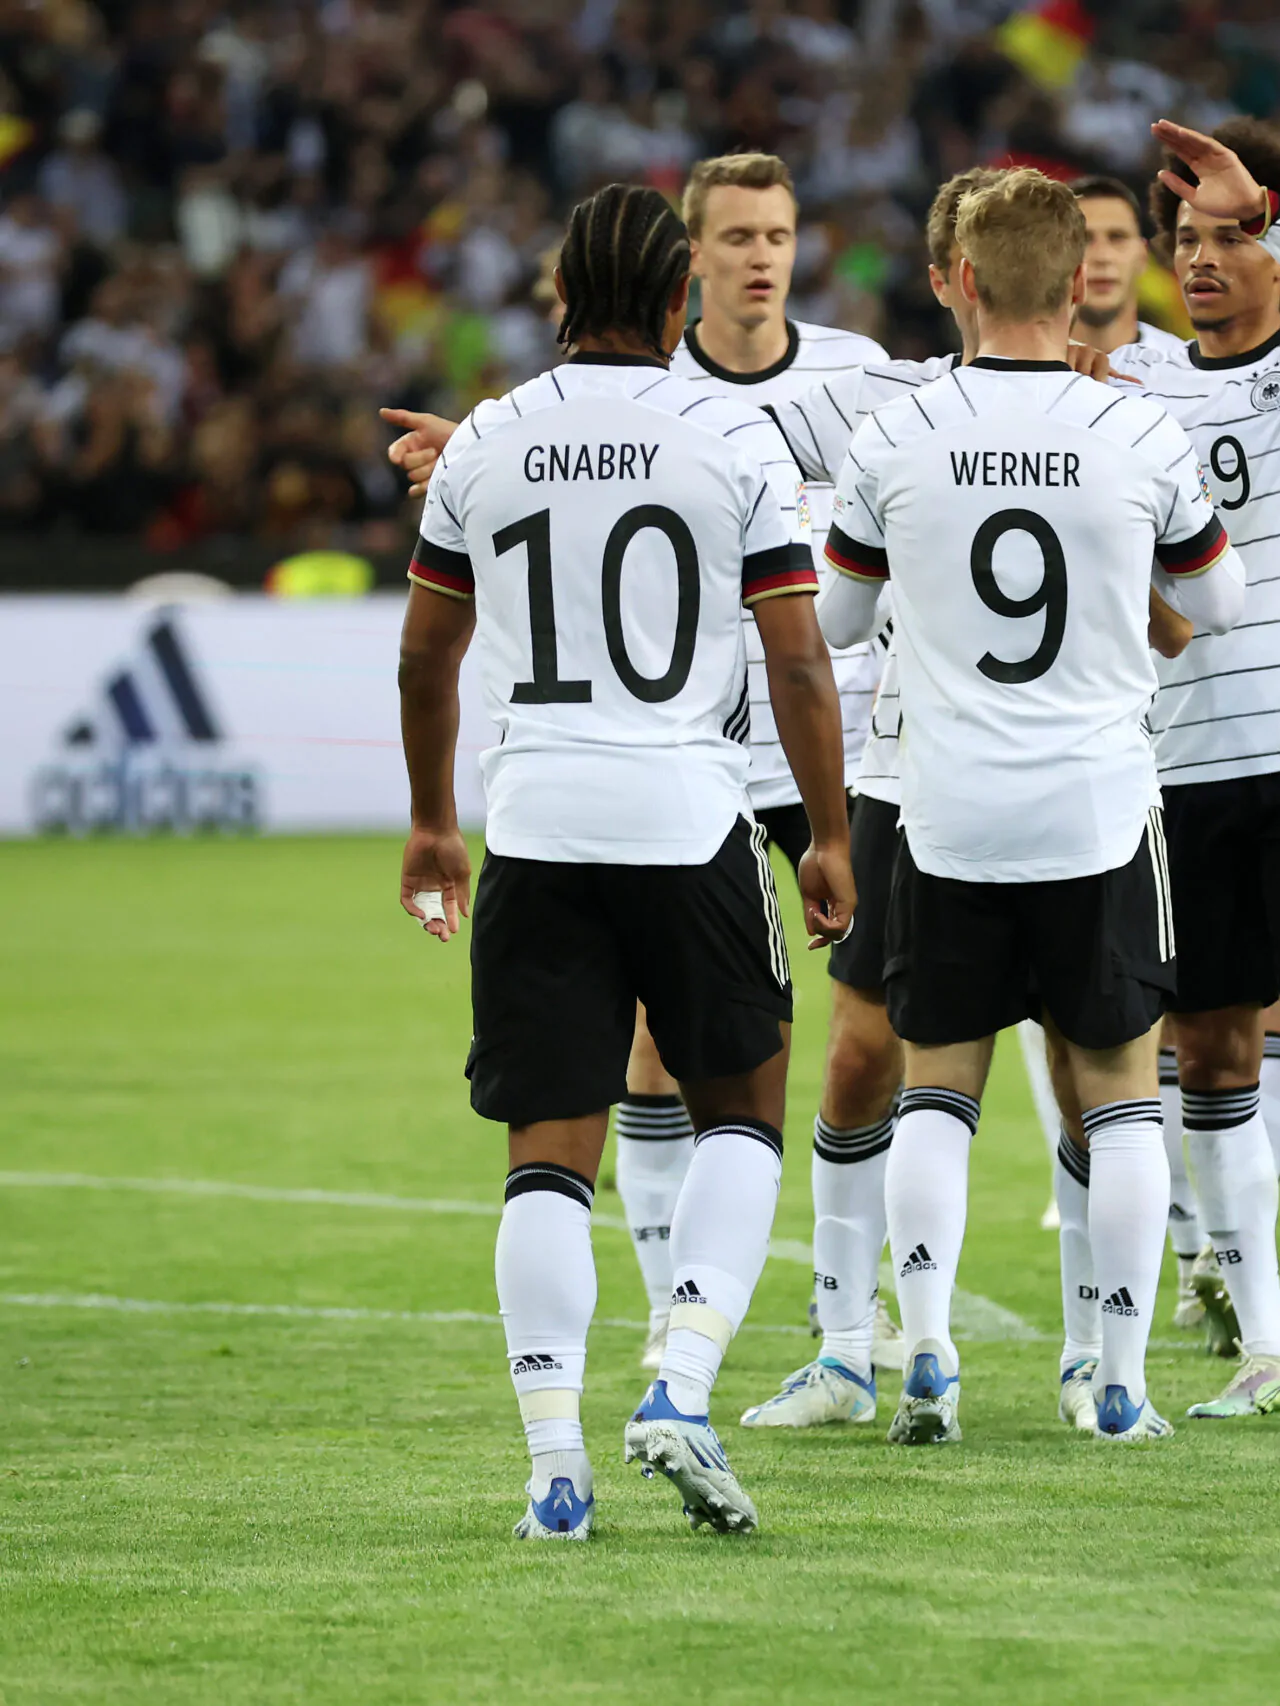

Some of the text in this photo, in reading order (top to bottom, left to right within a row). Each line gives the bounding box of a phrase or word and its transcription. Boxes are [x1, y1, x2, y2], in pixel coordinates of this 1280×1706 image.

[524, 442, 660, 483] GNABRY
[950, 451, 1081, 487] WERNER
[1210, 435, 1251, 510] 9
[491, 504, 701, 704] 10
[970, 508, 1068, 685] 9
[900, 1261, 938, 1278] adidas
[1215, 1249, 1243, 1266] FB
[814, 1272, 838, 1290] FB
[1101, 1304, 1139, 1317] adidas
[513, 1362, 563, 1375] adidas
